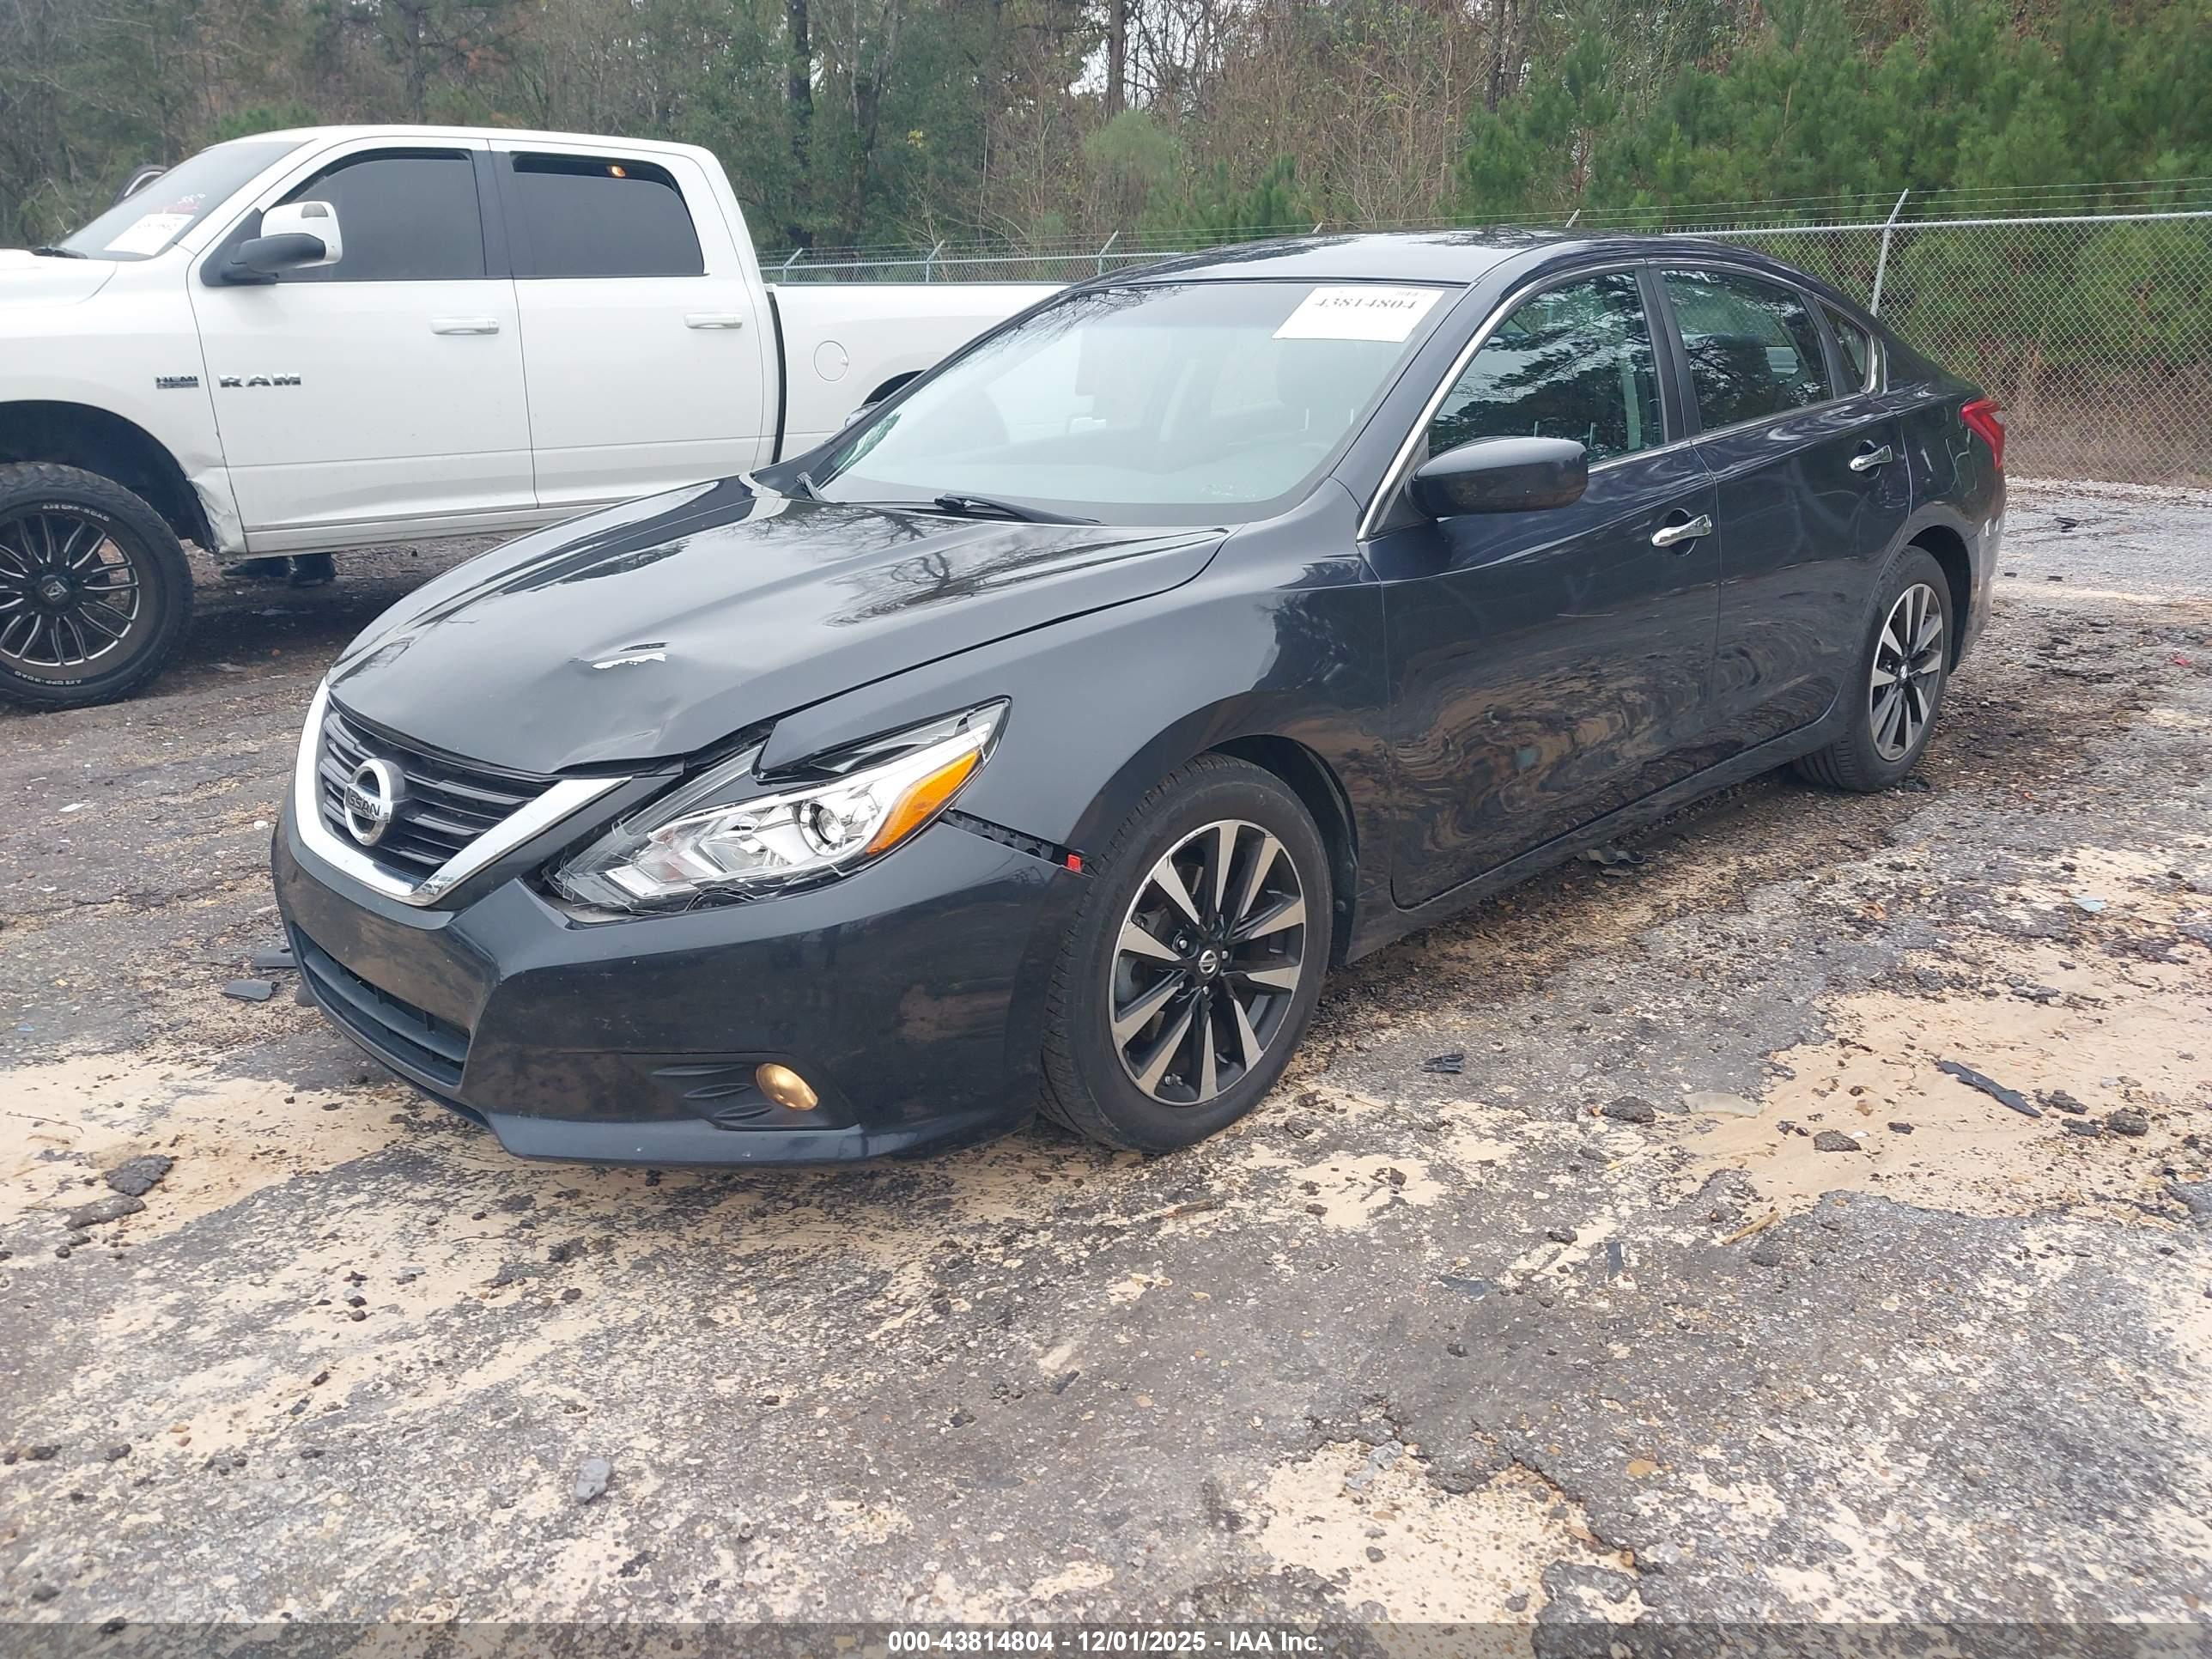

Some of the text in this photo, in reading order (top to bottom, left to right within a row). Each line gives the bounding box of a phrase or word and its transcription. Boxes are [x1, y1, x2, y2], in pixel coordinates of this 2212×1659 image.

[1314, 297, 1418, 310] 43814804
[219, 373, 301, 388] RAM
[346, 789, 380, 817] SSAN
